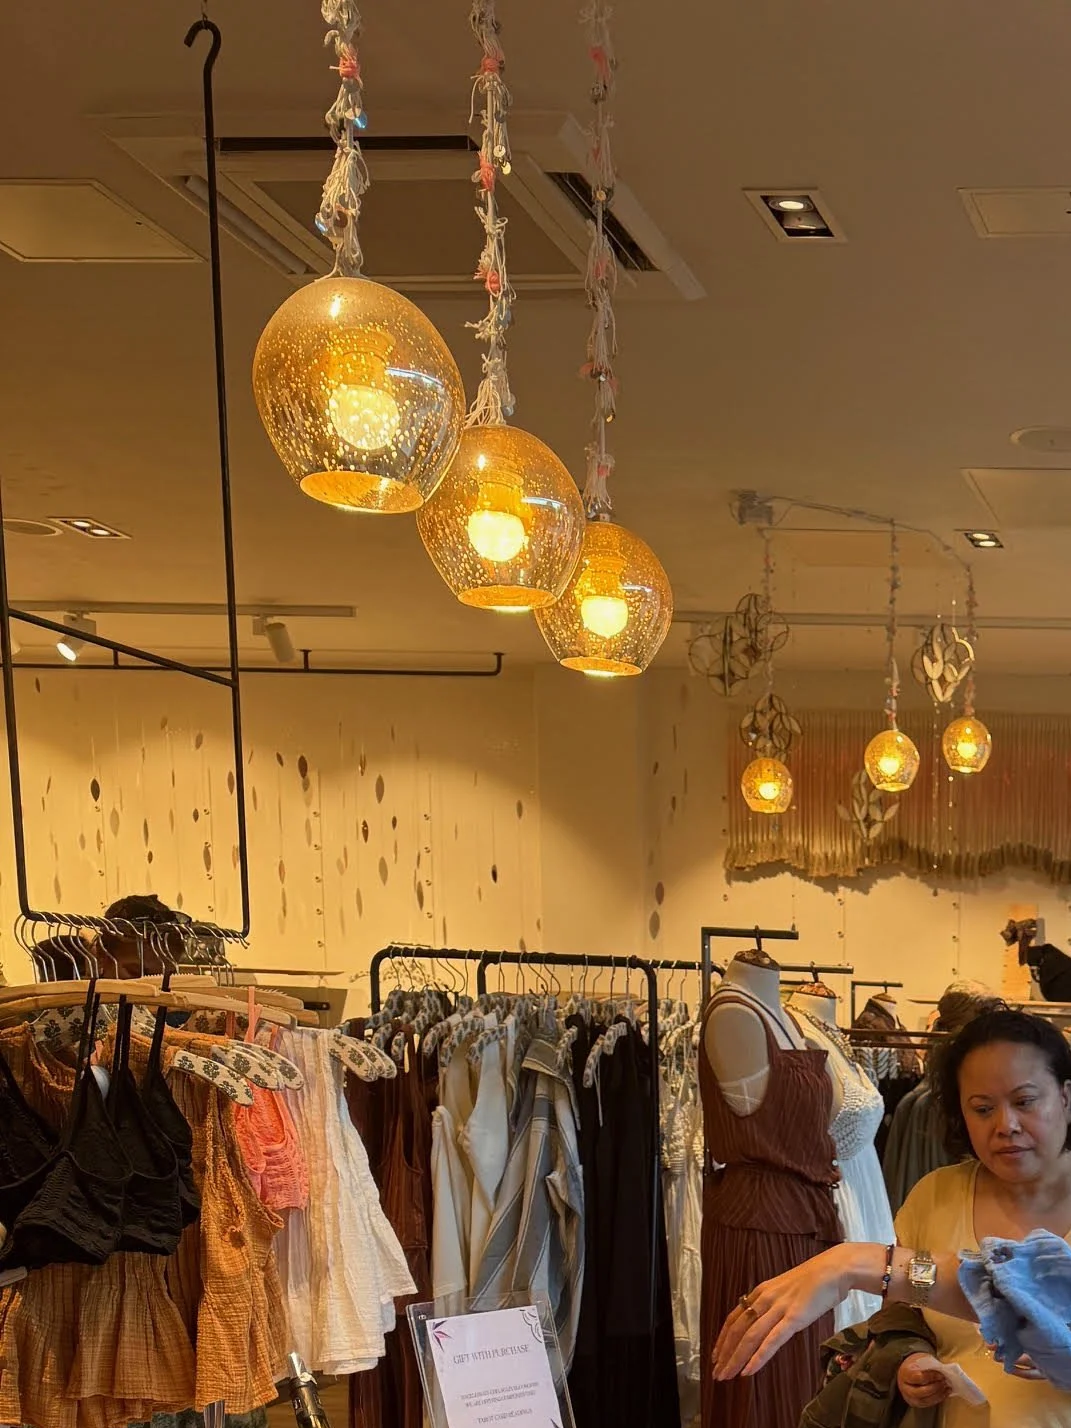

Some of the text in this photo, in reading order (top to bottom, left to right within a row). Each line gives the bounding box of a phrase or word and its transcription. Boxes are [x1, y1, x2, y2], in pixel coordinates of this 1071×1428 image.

[453, 1344, 529, 1364] GIFT WITH PURCHASE
